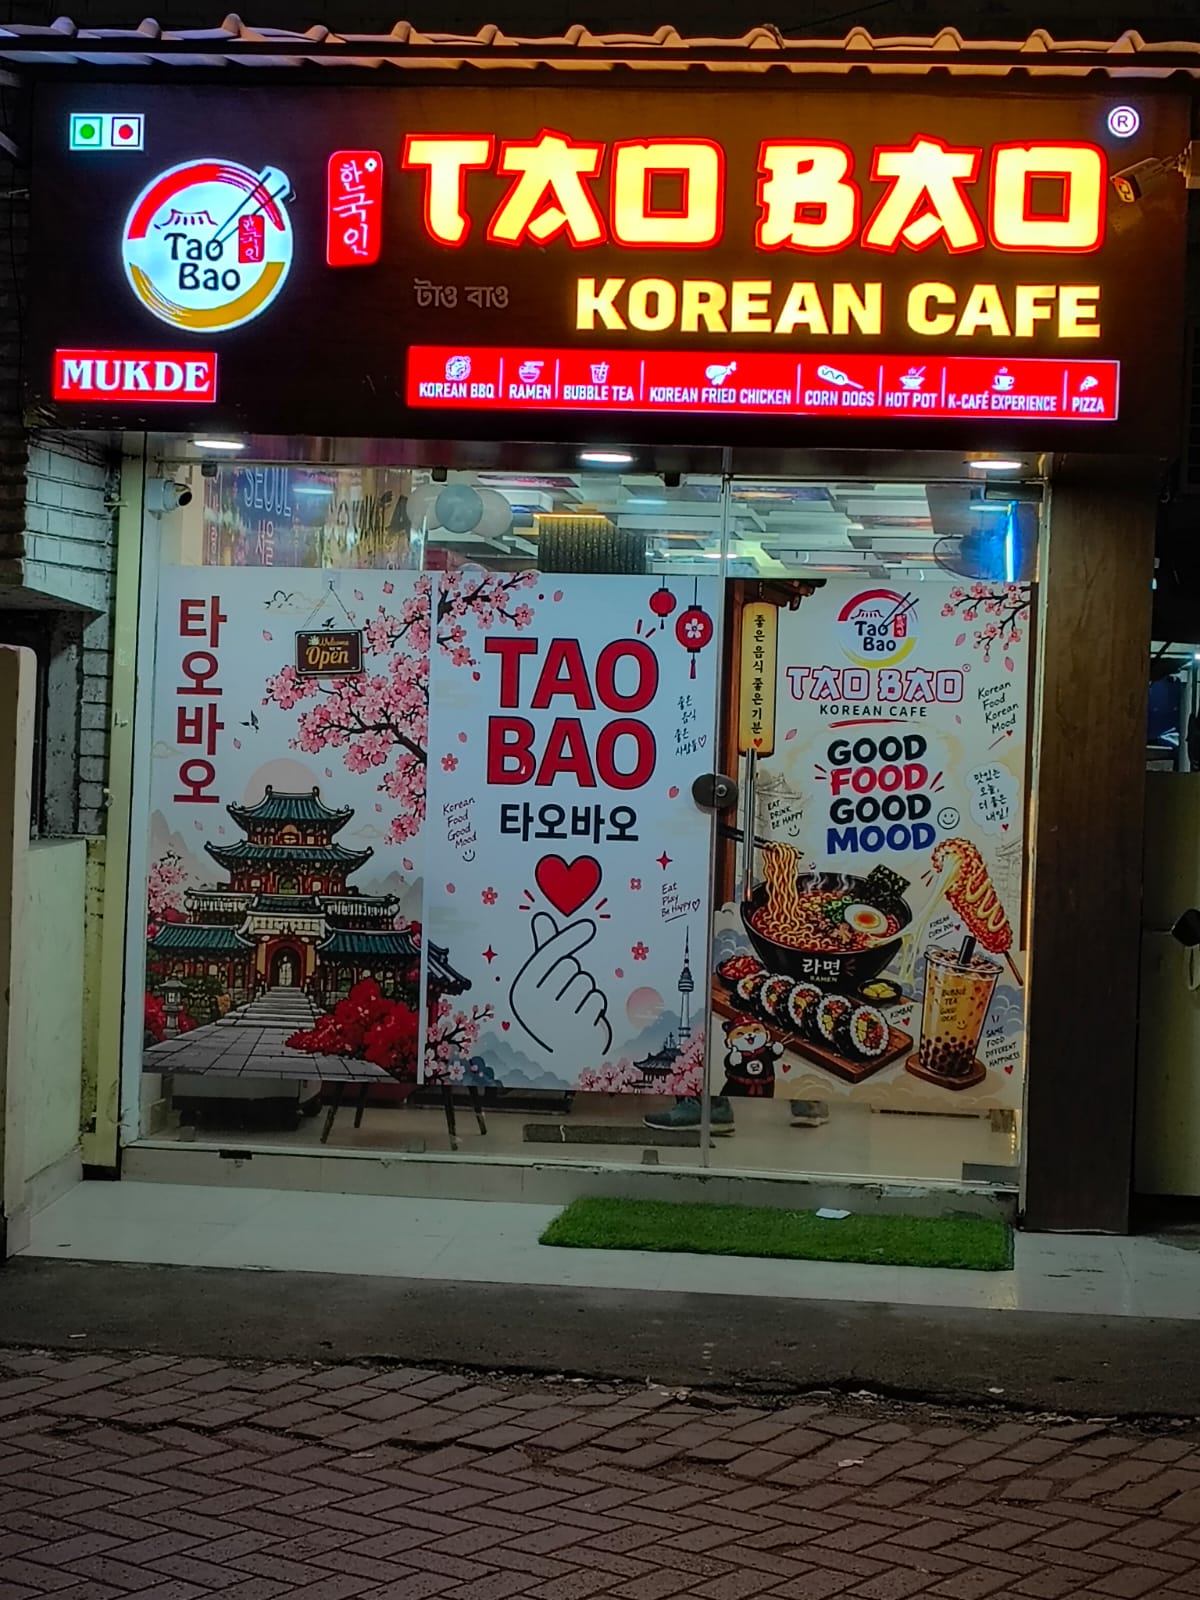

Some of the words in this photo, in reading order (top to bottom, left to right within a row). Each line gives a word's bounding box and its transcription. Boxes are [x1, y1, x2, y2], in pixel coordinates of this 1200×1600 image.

[402, 127, 724, 249] TAO
[755, 132, 1108, 254] BAO
[333, 159, 374, 257] 한국인
[163, 233, 224, 262] Tao
[179, 262, 241, 291] Bao
[464, 285, 509, 309] বাও
[575, 277, 882, 335] KOREAN
[907, 282, 1102, 339] CAFE
[61, 359, 210, 392] MUKDE
[419, 382, 467, 398] KOREAN
[470, 383, 494, 398] BBQ
[509, 384, 552, 400] RAMEN
[563, 384, 608, 401] BUBBLE
[612, 386, 634, 401] TEA
[650, 386, 698, 403] KOREAN
[701, 387, 736, 404] FRIED
[739, 388, 791, 405] CHICKEN
[805, 390, 838, 406] CORN
[842, 390, 874, 407] DOGS
[885, 391, 909, 408] HOT
[912, 392, 937, 408] POT
[948, 390, 988, 410] K-CAFÉ
[991, 394, 1057, 411] EXPERIENCE
[1072, 396, 1104, 413] PIZZA
[244, 467, 292, 517] SEOUL
[854, 620, 889, 637] Tao
[863, 636, 897, 652] Bao
[305, 646, 350, 670] Open
[484, 637, 659, 713] TAO
[786, 665, 871, 701] TAO
[877, 667, 964, 703] BAO
[173, 595, 228, 804] 타오바오
[977, 681, 1012, 700] Korean
[820, 704, 882, 717] KOREAN
[889, 706, 928, 718] CAFE
[983, 692, 1006, 711] Food
[985, 703, 1019, 724] Korean
[992, 712, 1017, 735] Mood
[486, 715, 657, 790] BAO
[827, 734, 927, 767] GOOD
[830, 763, 929, 796] FOOD
[442, 796, 476, 817] Korean
[829, 794, 932, 825] GOOD
[978, 799, 988, 810] 더
[447, 808, 469, 829] Food
[500, 802, 639, 844] 타오바오
[447, 821, 471, 842] Good
[455, 830, 477, 849] Mood
[827, 822, 936, 855] MOOD
[661, 881, 678, 896] Eat
[802, 958, 841, 976] 라면
